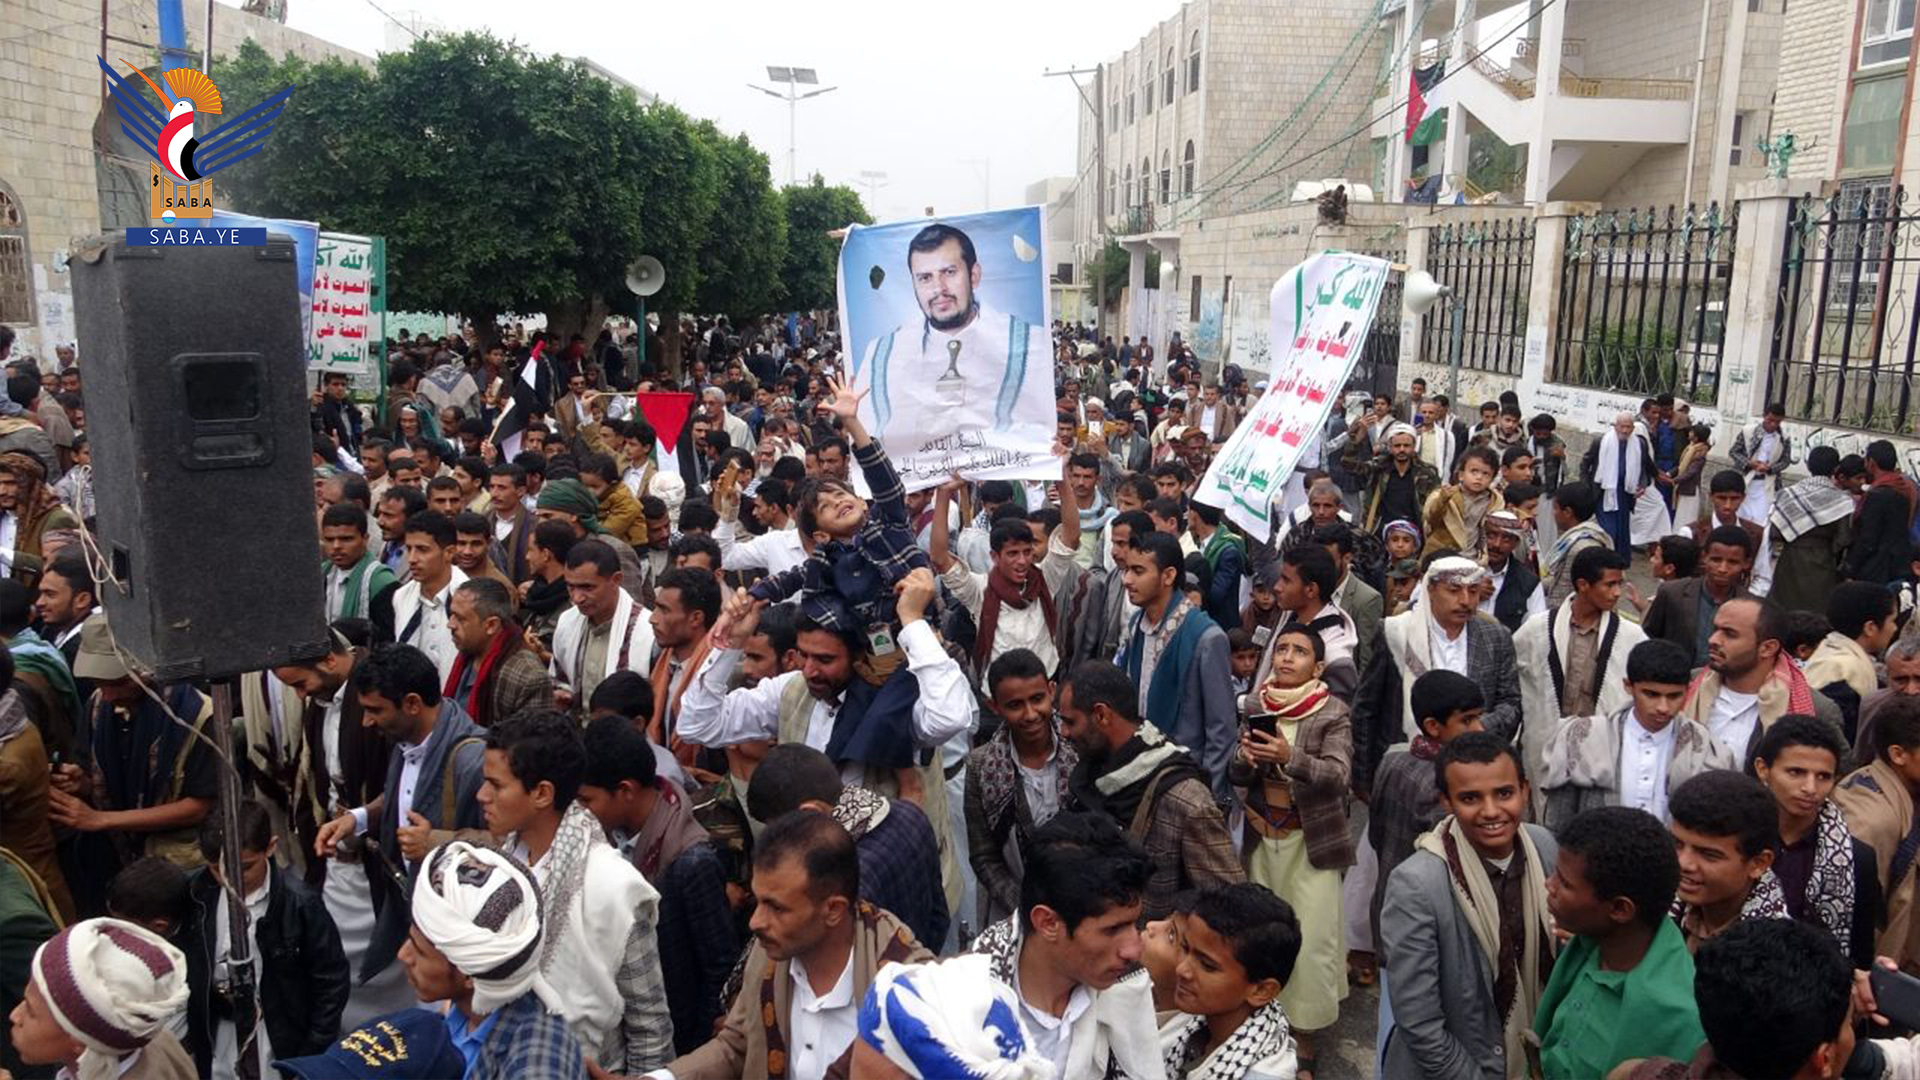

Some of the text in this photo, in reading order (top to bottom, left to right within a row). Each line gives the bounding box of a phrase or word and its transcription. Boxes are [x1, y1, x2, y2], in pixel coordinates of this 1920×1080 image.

[339, 247, 370, 270] الله
[332, 279, 369, 295] الموت
[1342, 265, 1380, 310] الله
[332, 302, 368, 318] الموت
[316, 321, 367, 339] اللعنة على
[327, 343, 366, 366] النصر
[1316, 328, 1360, 361] الموت
[1296, 376, 1337, 406] الموت
[919, 434, 953, 453] القائد
